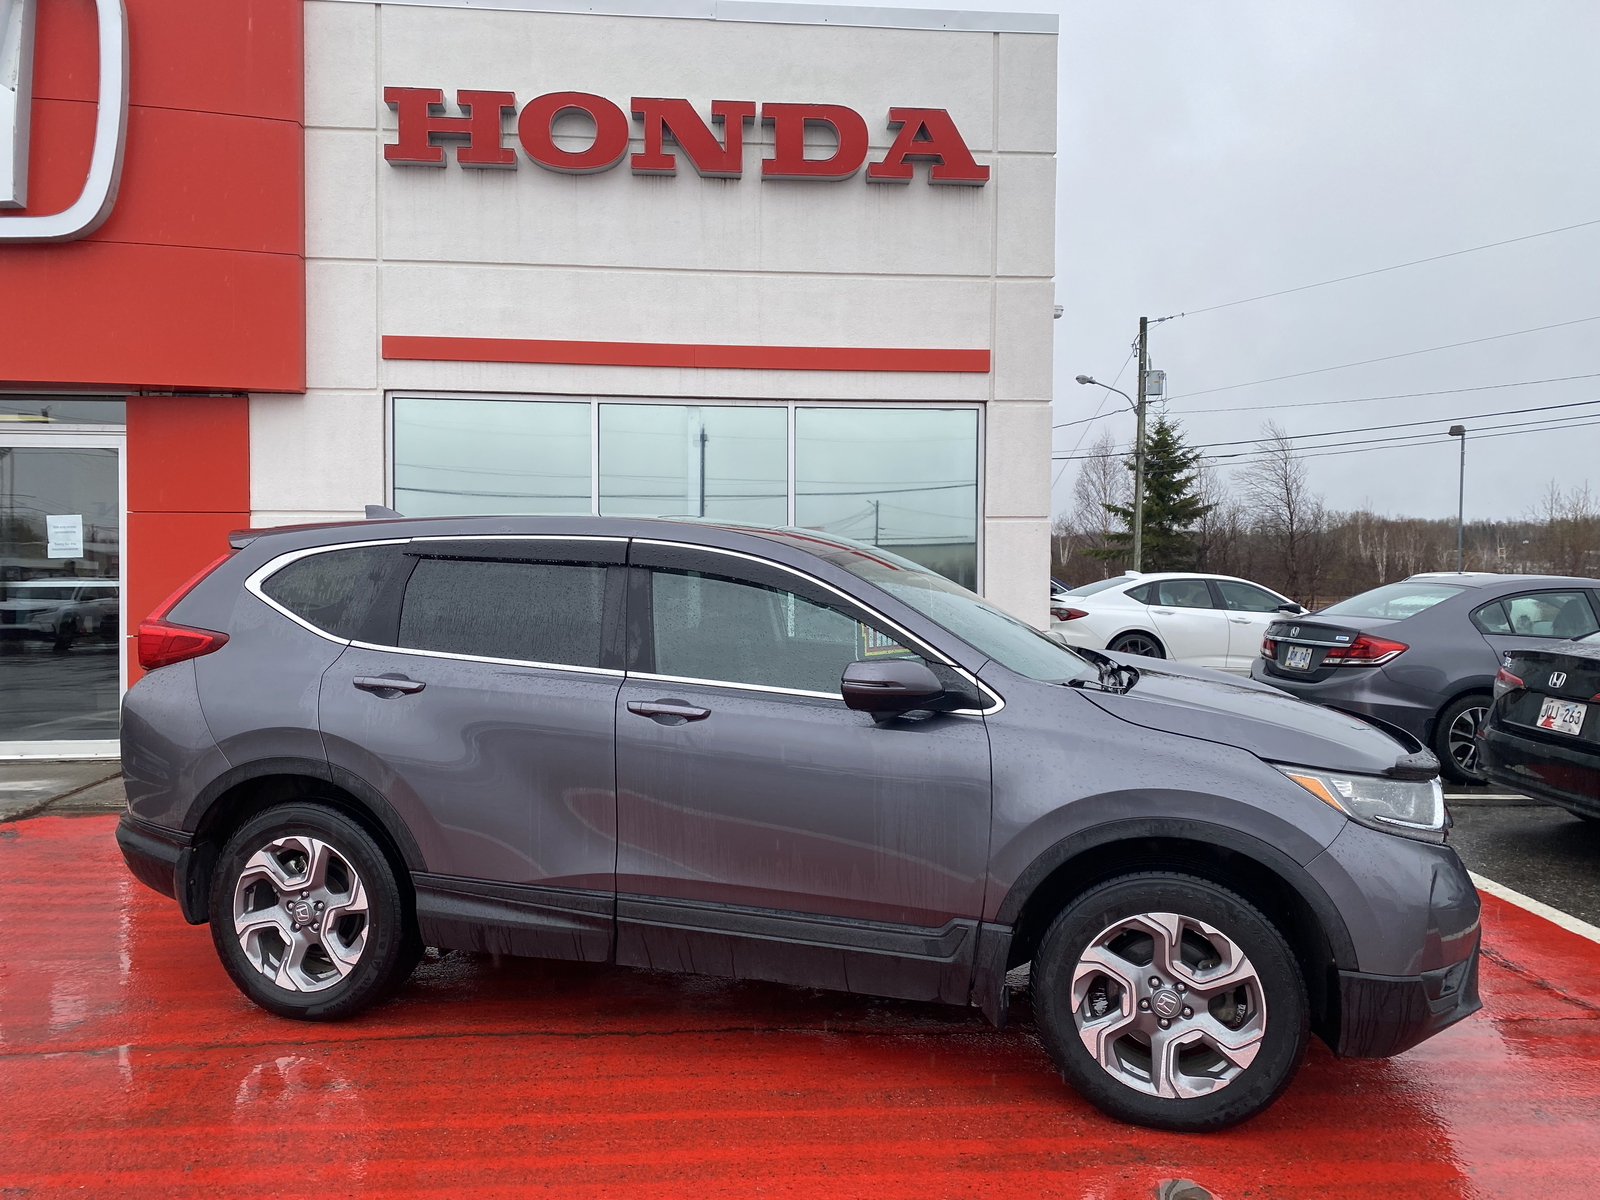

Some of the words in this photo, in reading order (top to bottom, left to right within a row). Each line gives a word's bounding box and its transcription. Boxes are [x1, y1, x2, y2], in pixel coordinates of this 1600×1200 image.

[384, 87, 990, 187] HONDA
[1541, 704, 1560, 720] JUJ
[1562, 708, 1582, 725] 263
